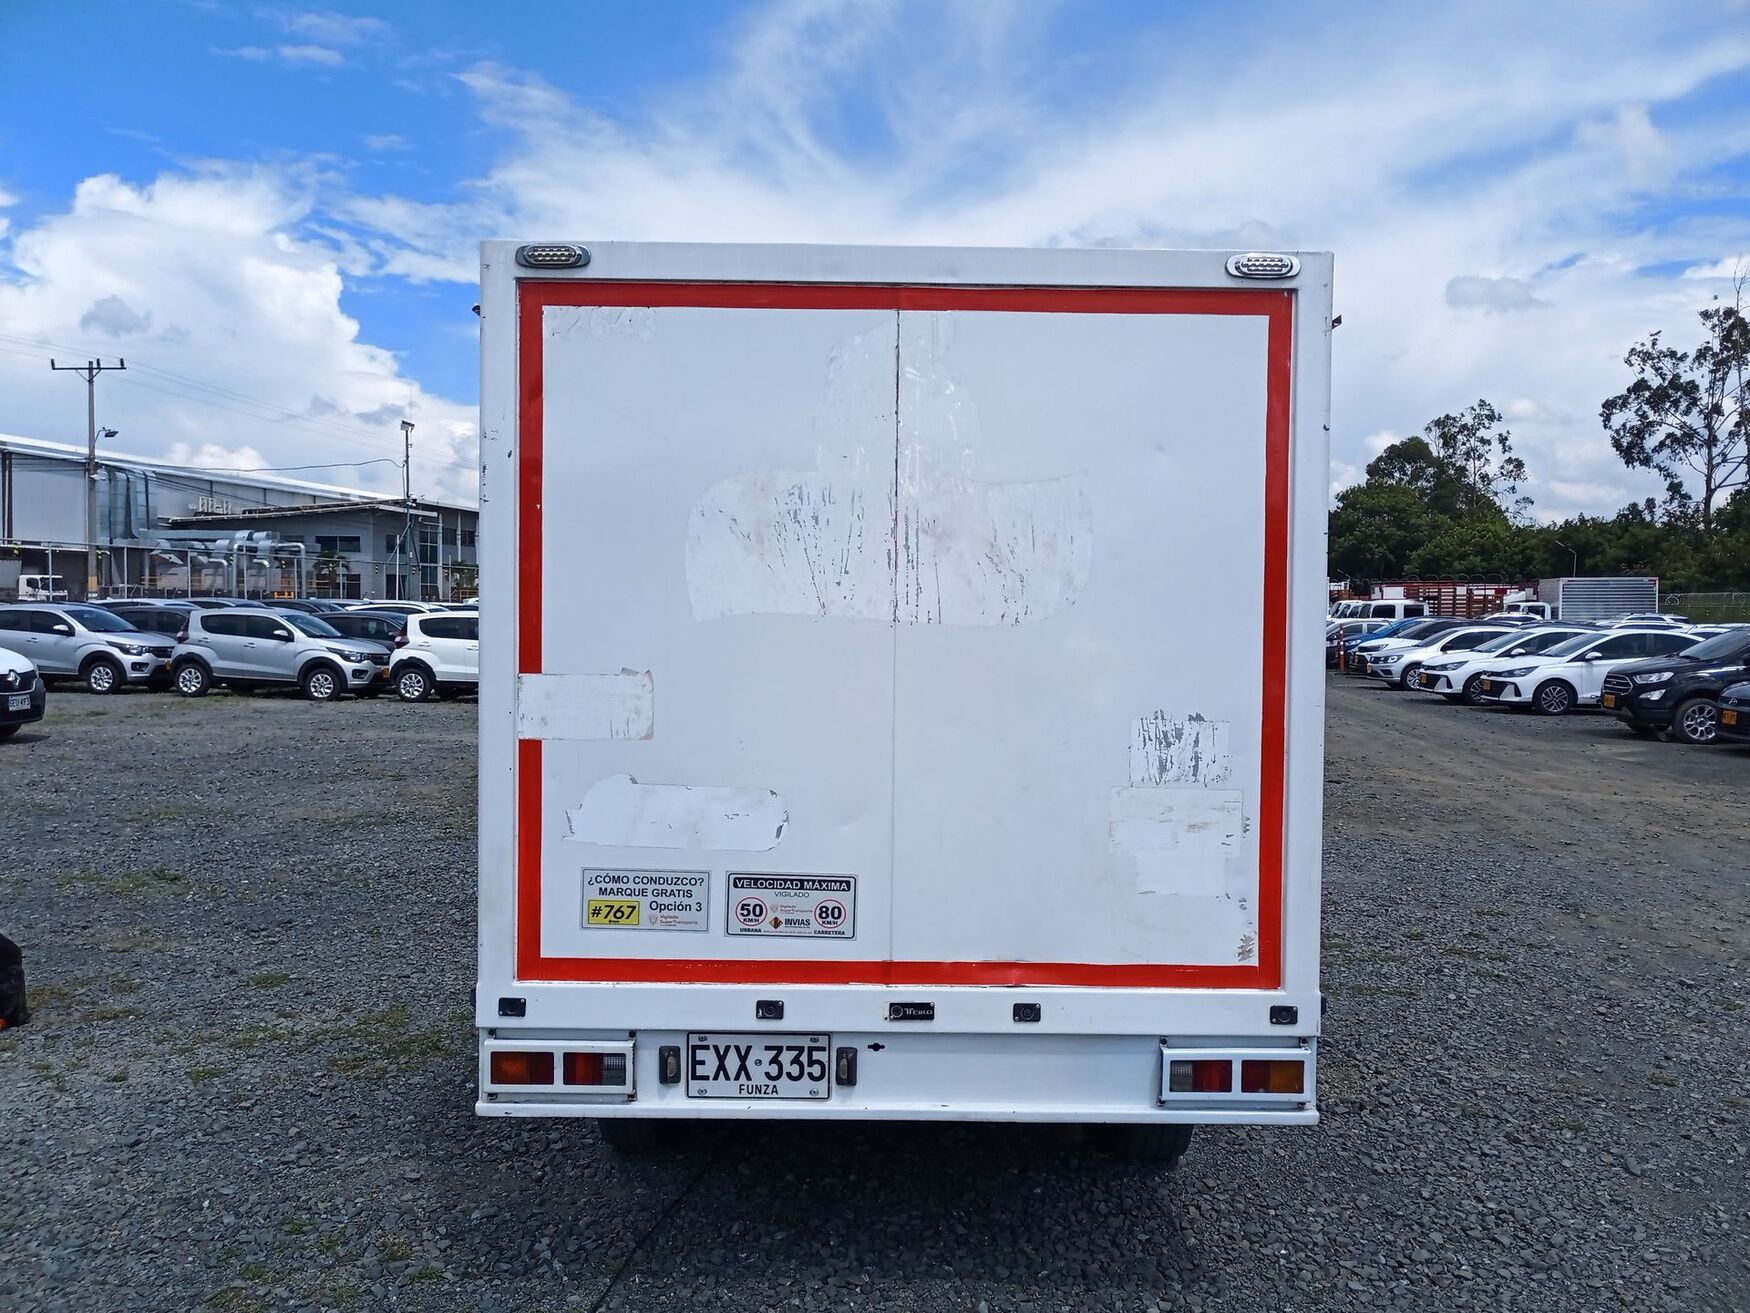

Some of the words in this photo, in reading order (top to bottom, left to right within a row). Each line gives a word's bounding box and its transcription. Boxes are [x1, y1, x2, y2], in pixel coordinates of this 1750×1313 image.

[587, 873, 630, 886] ¿CÓMO
[633, 875, 705, 888] CONDUZCO?
[736, 879, 801, 889] VELOCIDAD
[803, 879, 849, 891] MÁXIMA
[598, 887, 649, 897] MARQUE
[651, 888, 693, 898] GRATIS
[590, 904, 637, 920] #767
[649, 900, 692, 913] Opción
[695, 902, 702, 912] 3
[739, 903, 764, 918] 50
[818, 905, 842, 920] 80
[784, 918, 811, 926] INVIAS
[690, 1044, 753, 1082] EXX
[764, 1045, 827, 1082] 335
[738, 1084, 779, 1095] FUNZA
